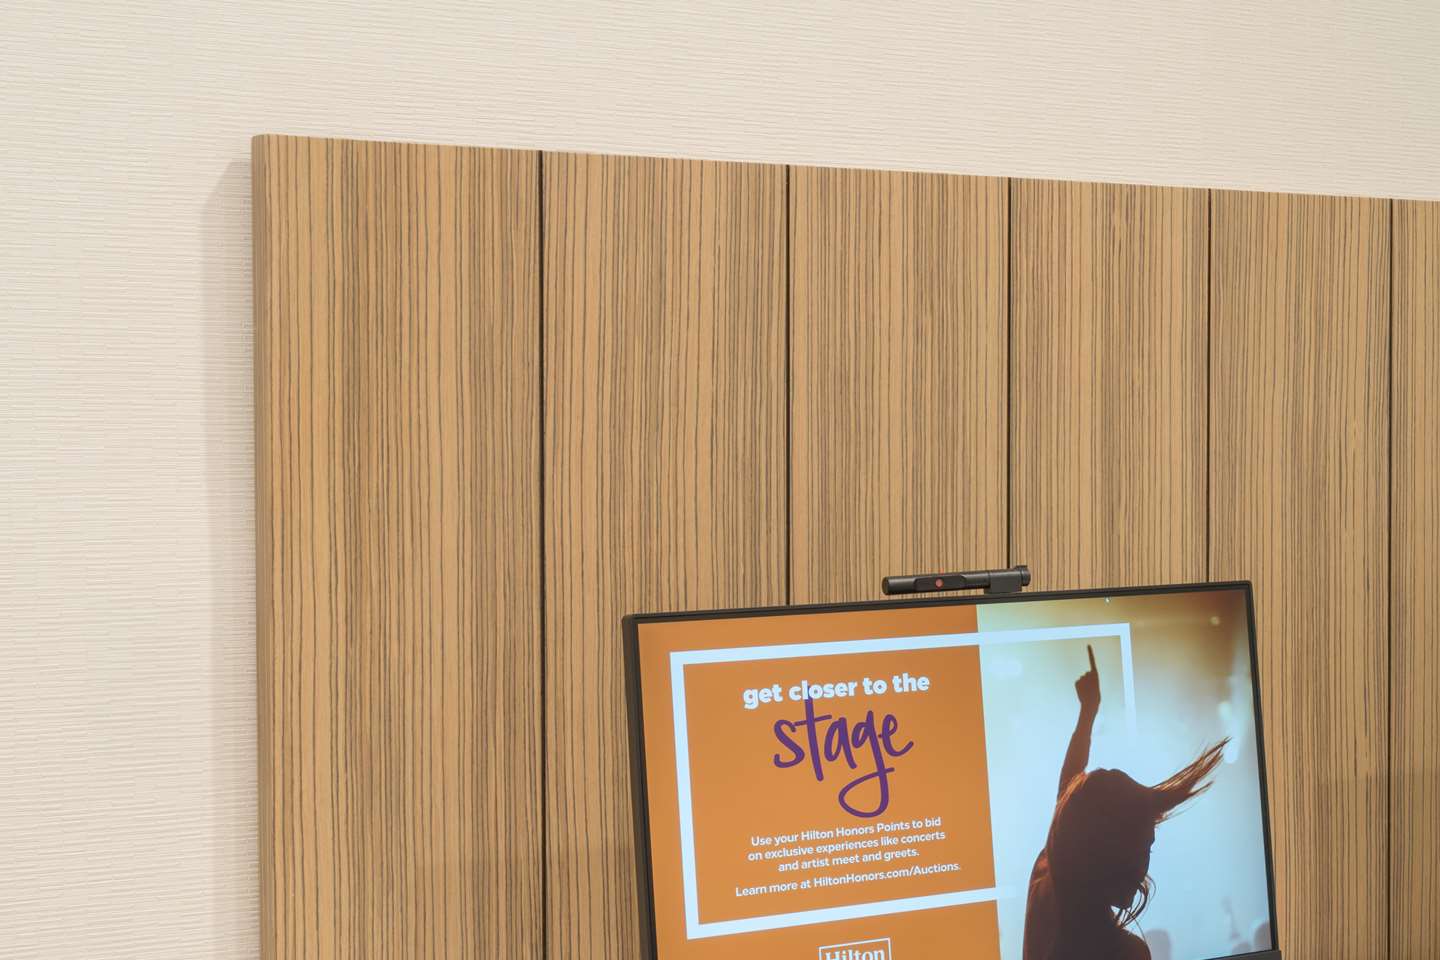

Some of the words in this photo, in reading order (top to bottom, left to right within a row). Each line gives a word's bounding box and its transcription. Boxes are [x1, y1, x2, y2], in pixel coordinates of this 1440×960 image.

[743, 684, 783, 710] get
[788, 679, 858, 700] closer
[862, 677, 888, 695] to
[892, 672, 930, 692] the
[773, 686, 914, 818] stage
[748, 851, 763, 862] on
[764, 845, 814, 860] exclusive
[815, 838, 879, 855] experiences
[880, 834, 899, 847] like
[900, 830, 946, 844] concerts
[751, 835, 772, 847] Use
[774, 832, 799, 847] your
[801, 829, 834, 841] Hilton
[835, 825, 875, 839] Honors
[876, 820, 910, 833] Points
[911, 819, 923, 829] to
[924, 816, 942, 828] bid
[778, 861, 799, 872] and
[801, 857, 830, 870] artist
[832, 853, 860, 866] meet
[862, 850, 882, 863] and
[883, 847, 920, 862] greets.
[735, 886, 767, 898] Learn
[769, 881, 798, 893] more
[800, 879, 811, 889] at
[813, 861, 961, 888] HiltonHonors.com/Auctions.
